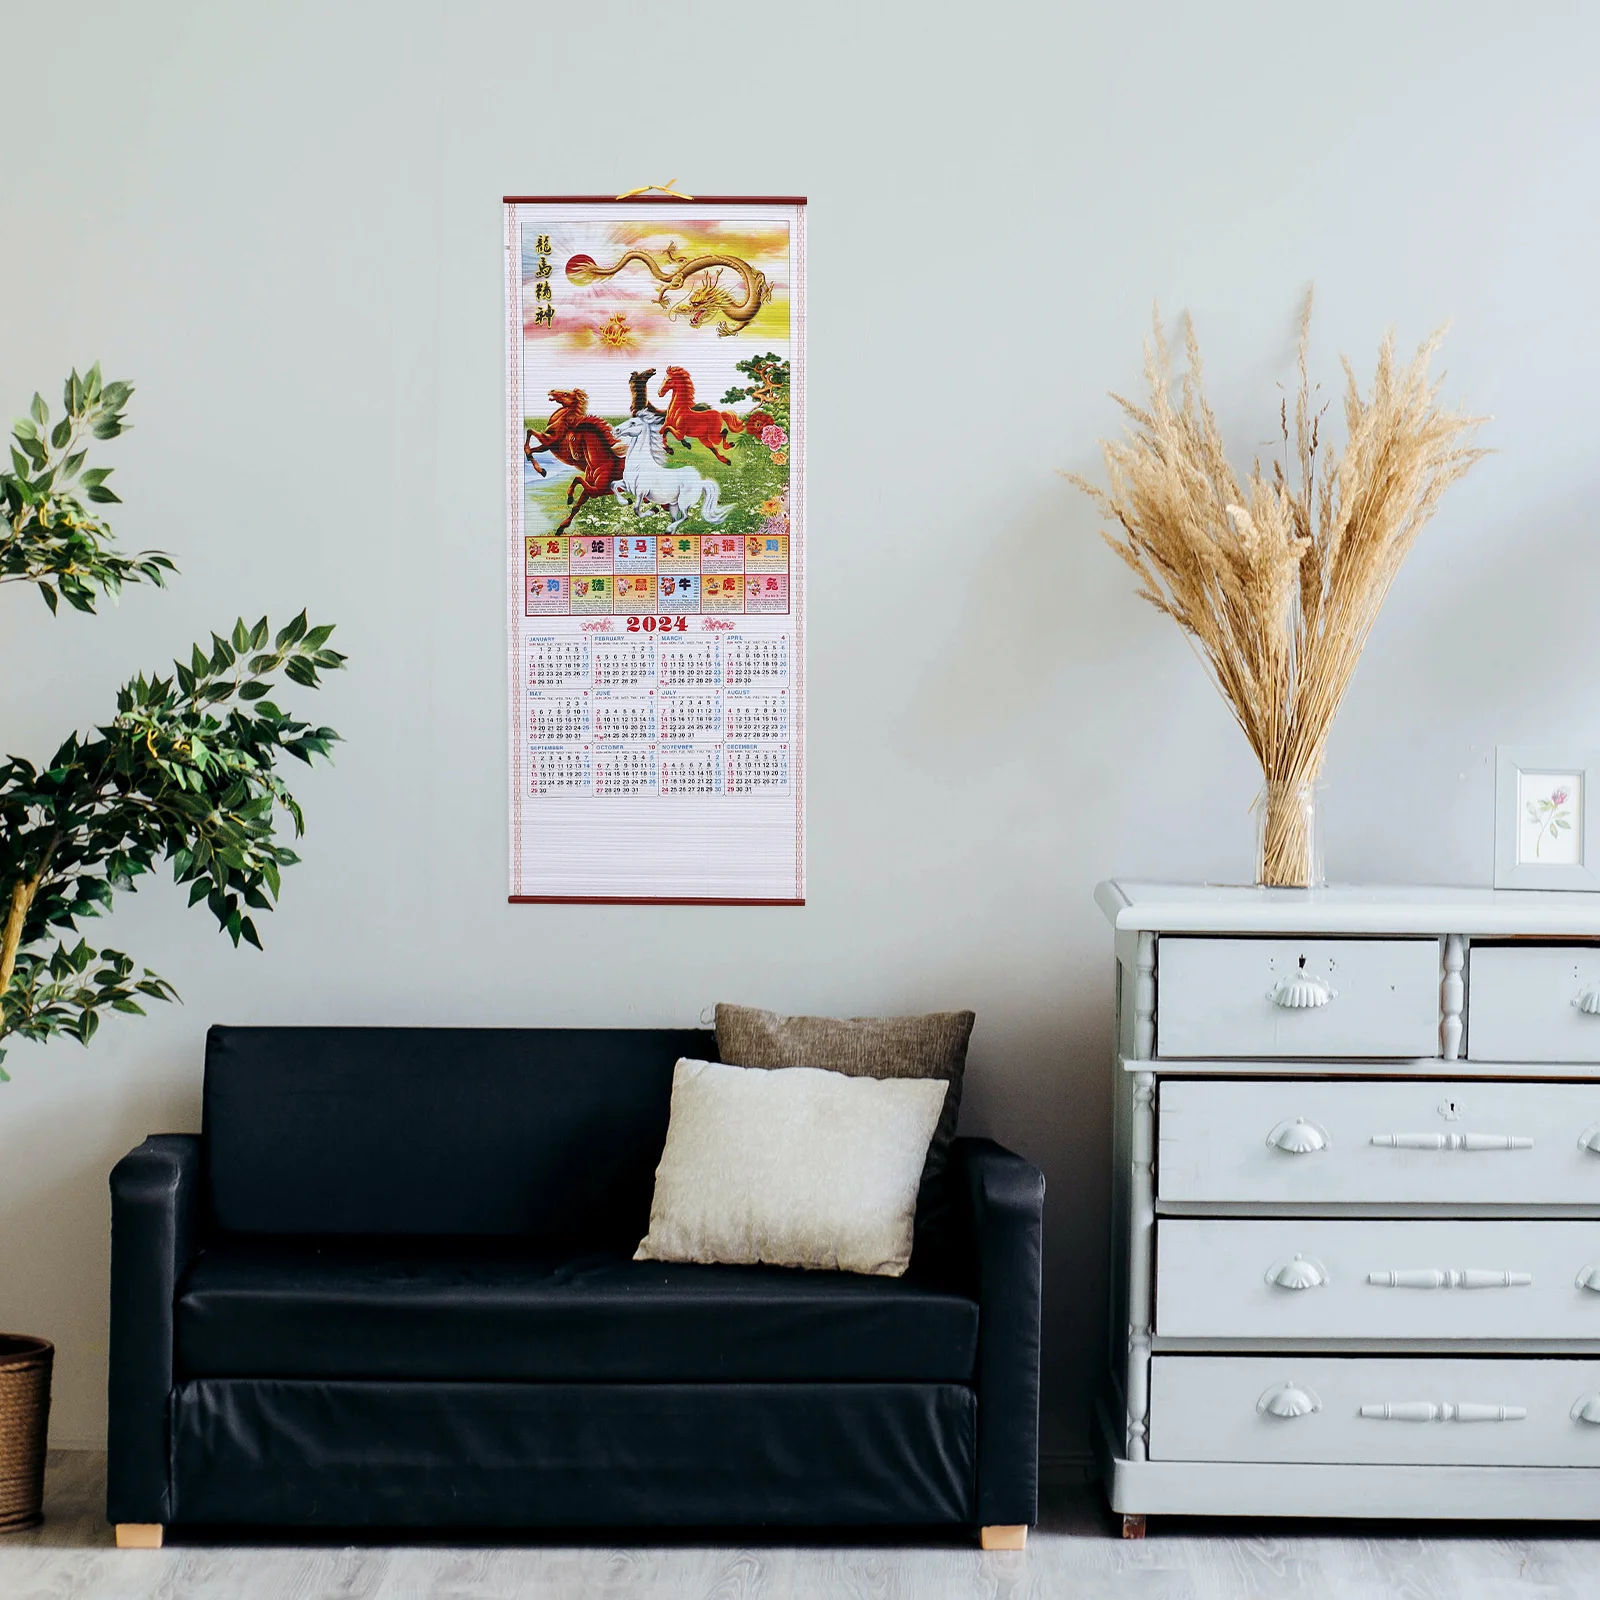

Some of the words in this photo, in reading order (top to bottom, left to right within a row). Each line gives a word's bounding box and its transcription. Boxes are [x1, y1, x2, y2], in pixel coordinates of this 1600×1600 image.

[534, 234, 556, 329] 龍馬精神
[547, 540, 560, 554] 龙
[591, 540, 604, 553] 蛇
[634, 540, 647, 552] 马
[678, 540, 691, 552] 羊
[722, 539, 735, 552] 猴
[765, 539, 779, 552] 鸡
[547, 579, 560, 592] 狗
[591, 579, 604, 591] 猪
[678, 578, 691, 591] 牛
[722, 578, 736, 591] 虎
[765, 577, 779, 591] 兔
[626, 616, 688, 632] 2024
